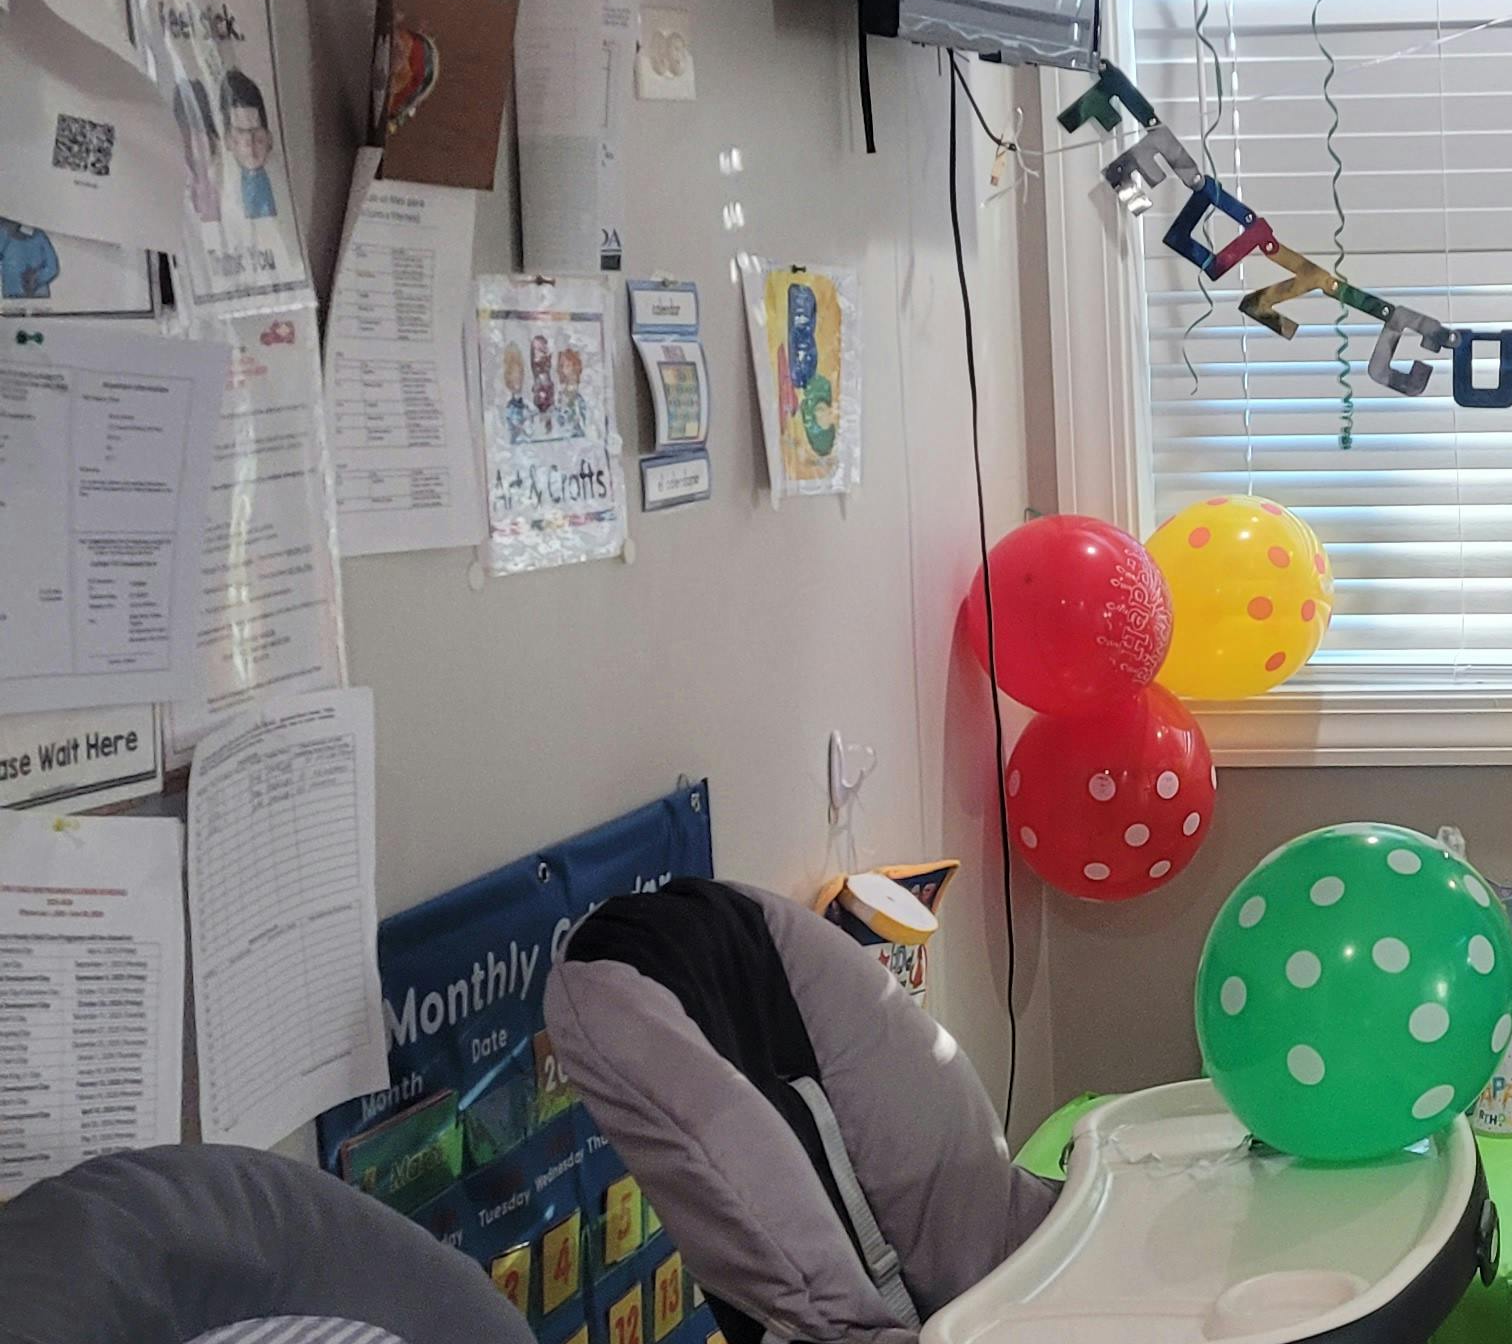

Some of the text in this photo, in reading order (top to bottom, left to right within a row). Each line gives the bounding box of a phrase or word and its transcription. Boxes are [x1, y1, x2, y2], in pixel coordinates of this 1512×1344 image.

[549, 459, 608, 503] Crafts
[37, 737, 80, 772] Wait
[86, 730, 138, 761] Here
[385, 940, 540, 1050] Monthly
[471, 1027, 508, 1063] Date
[362, 1072, 423, 1122] Month
[478, 1189, 532, 1228] Tuesday
[534, 1147, 585, 1192] Wednesday
[554, 1237, 571, 1285] 4
[615, 1190, 632, 1239] 5
[659, 1267, 680, 1323] 13
